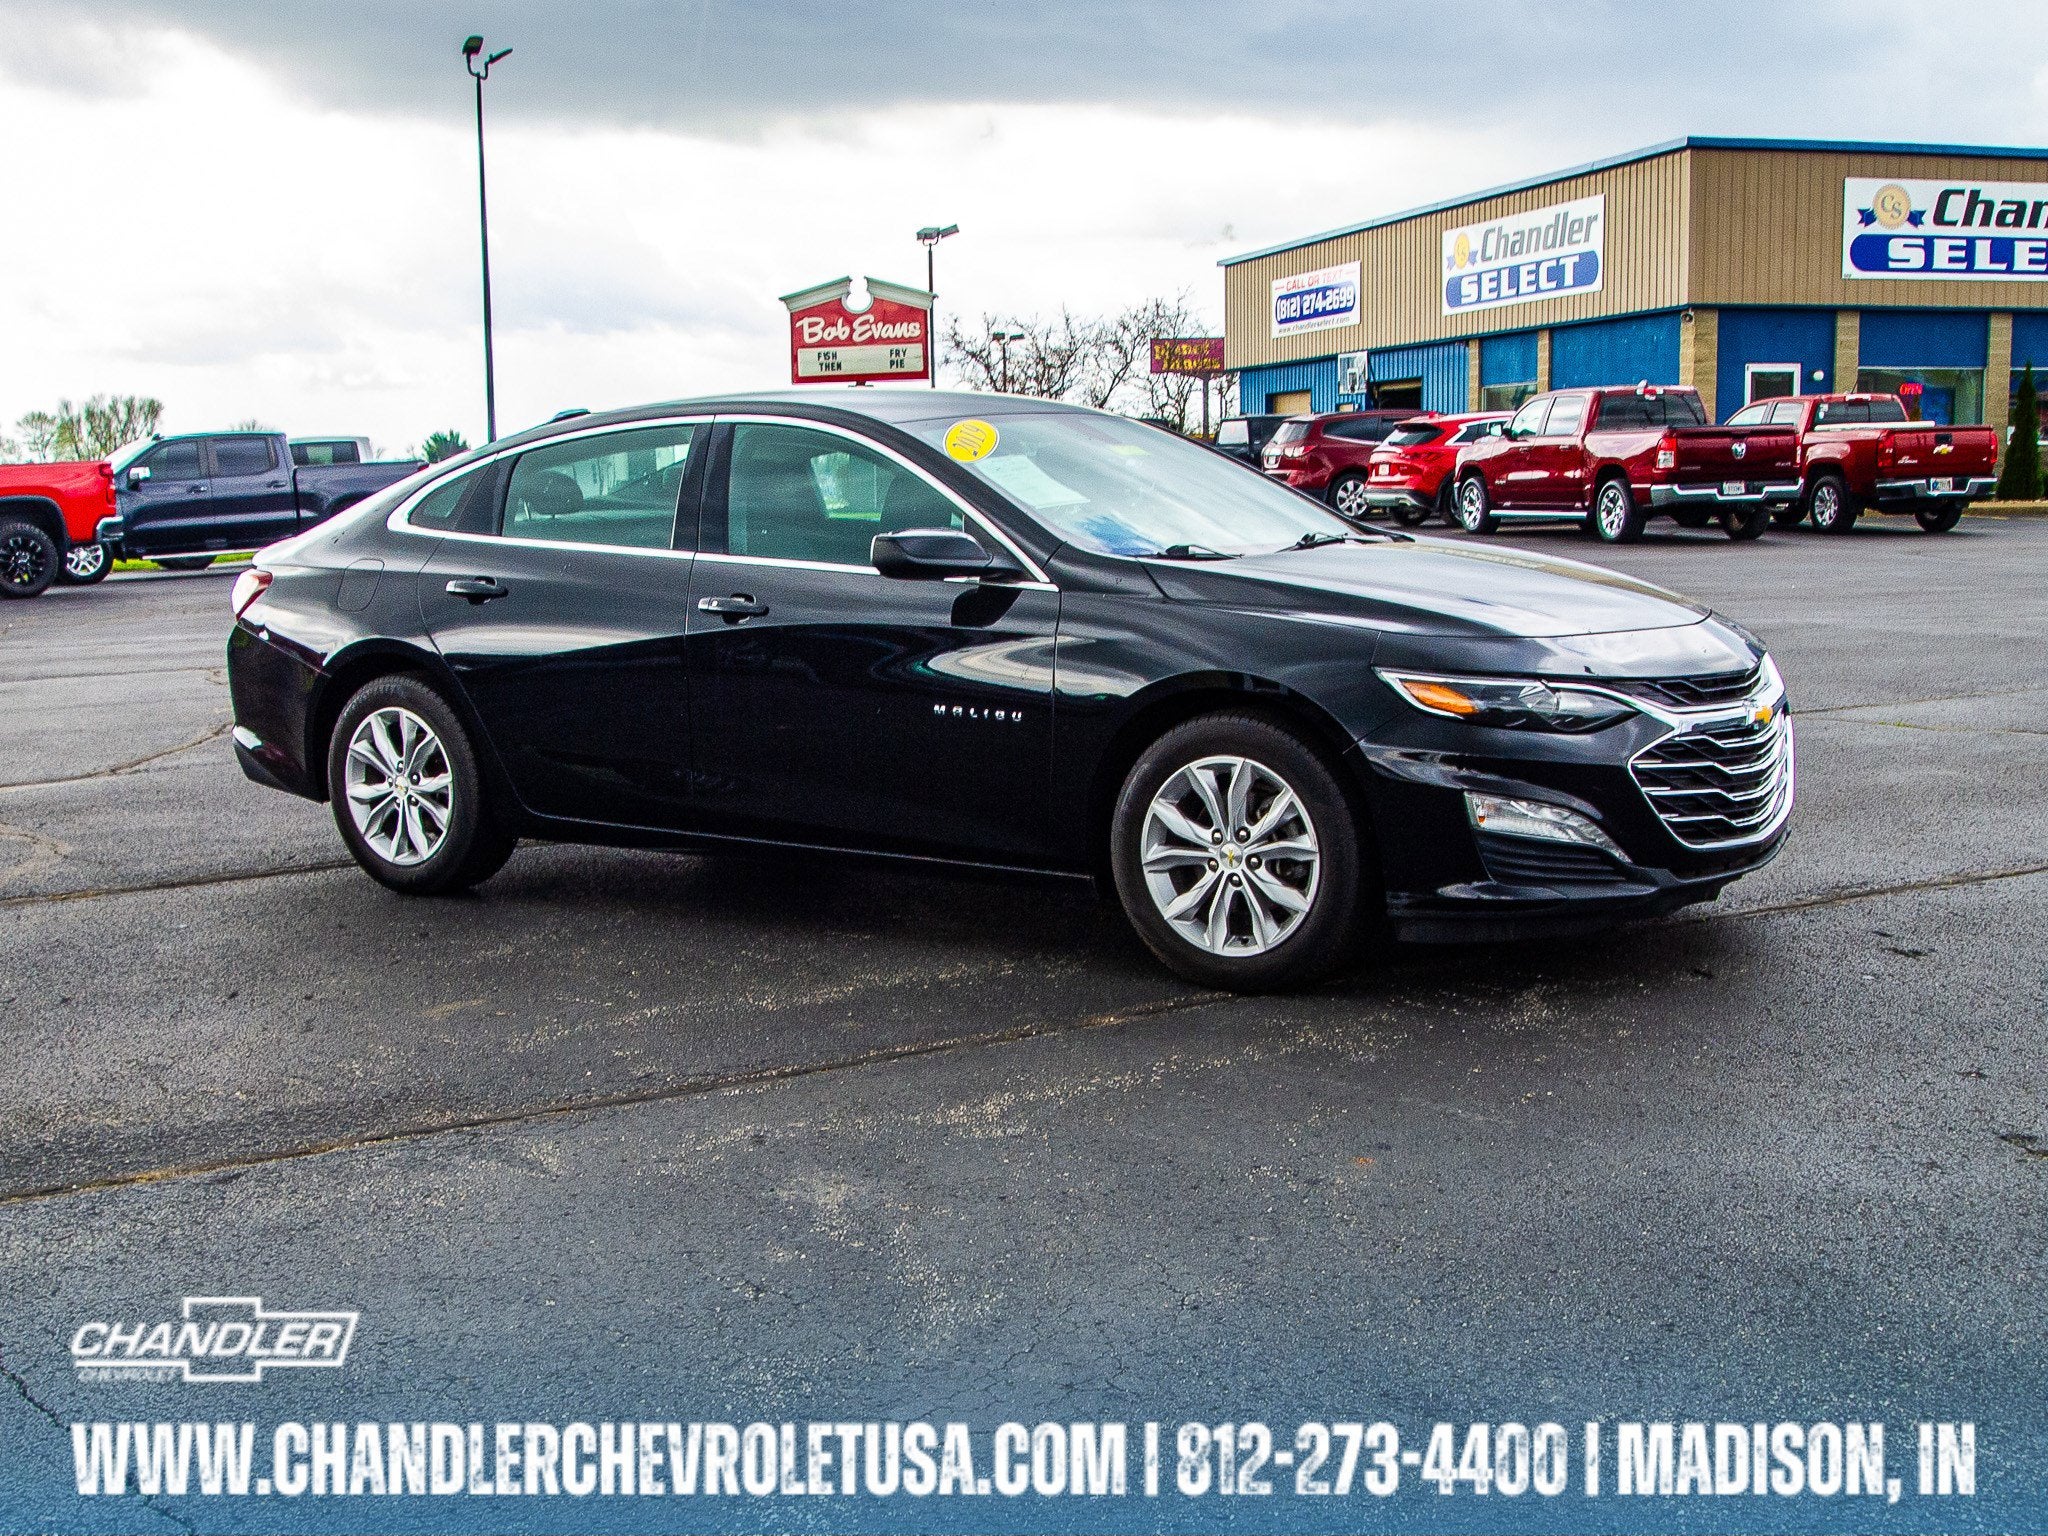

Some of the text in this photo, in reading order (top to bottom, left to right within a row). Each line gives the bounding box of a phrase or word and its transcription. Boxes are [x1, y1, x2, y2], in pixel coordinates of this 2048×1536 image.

[1481, 211, 1599, 262] Chandler
[1888, 237, 2047, 271] SELE
[1460, 254, 1580, 304] SELECT
[1277, 286, 1354, 321] (812) 274-2699
[796, 314, 921, 344] Bob Evans
[817, 348, 907, 361] FISH FRY
[819, 358, 905, 371] THEN PIE
[933, 704, 1022, 722] MALIBU
